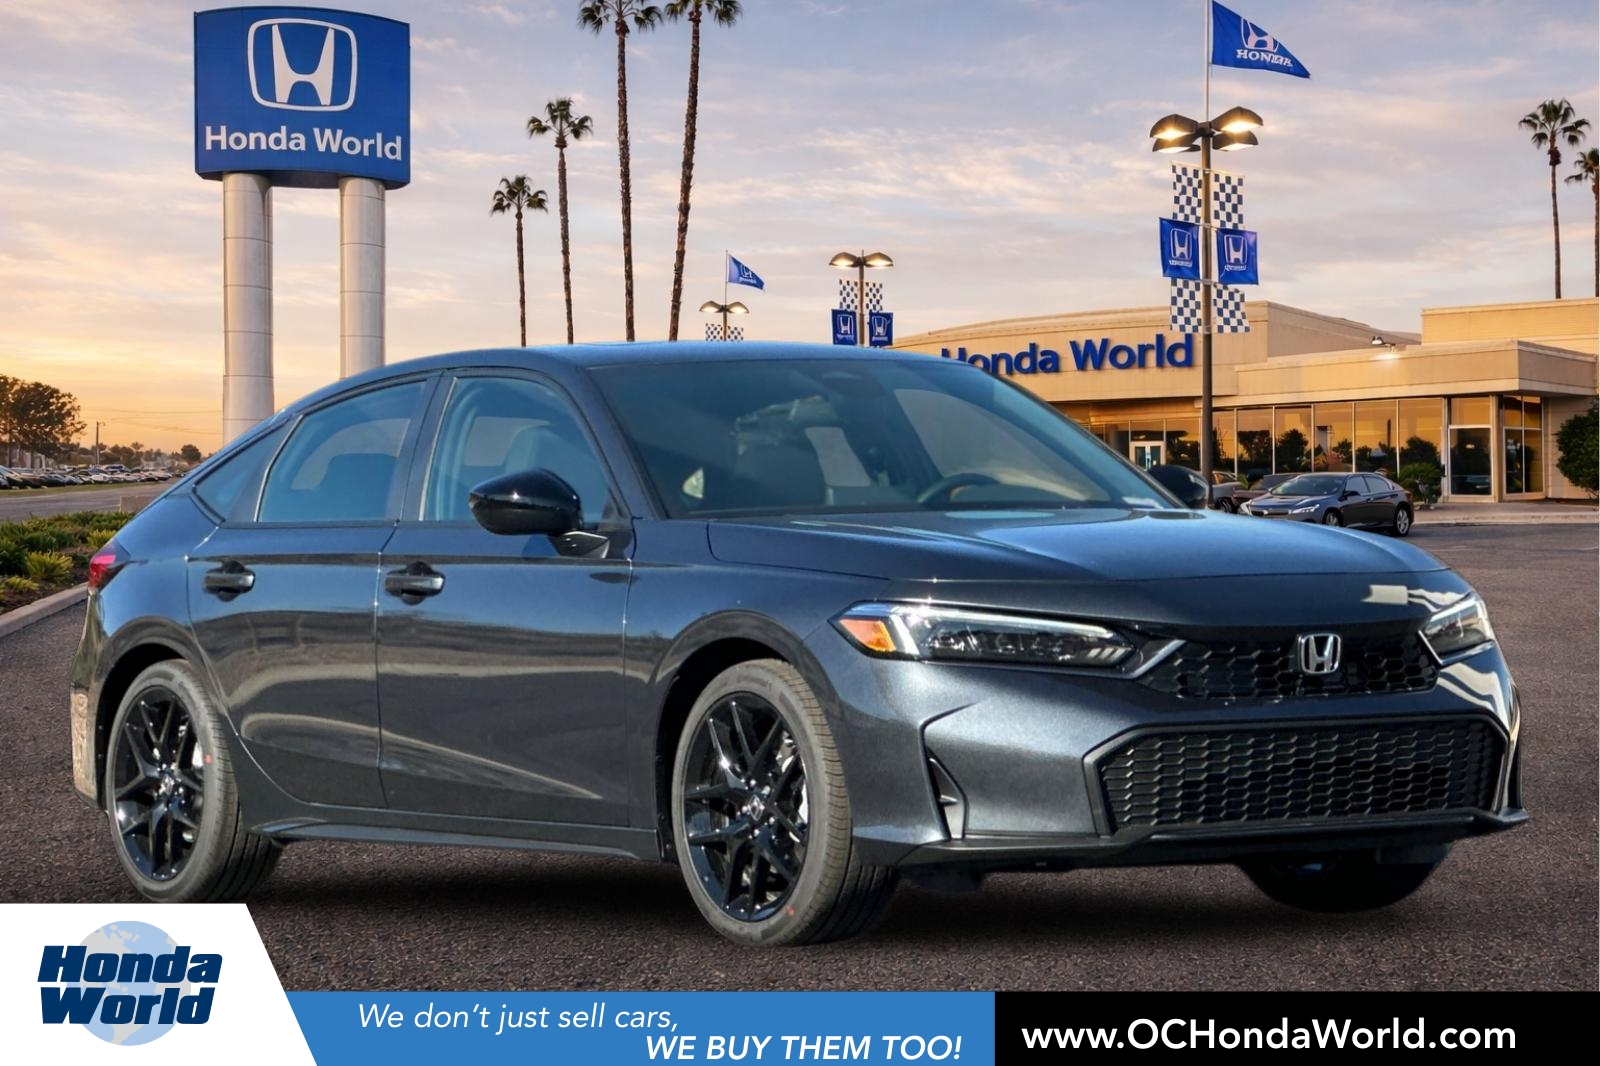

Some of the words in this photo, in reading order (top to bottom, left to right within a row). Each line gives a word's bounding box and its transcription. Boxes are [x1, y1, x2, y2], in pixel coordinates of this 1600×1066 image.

[205, 125, 306, 151] Honda
[313, 127, 402, 161] World
[1070, 333, 1193, 371] World
